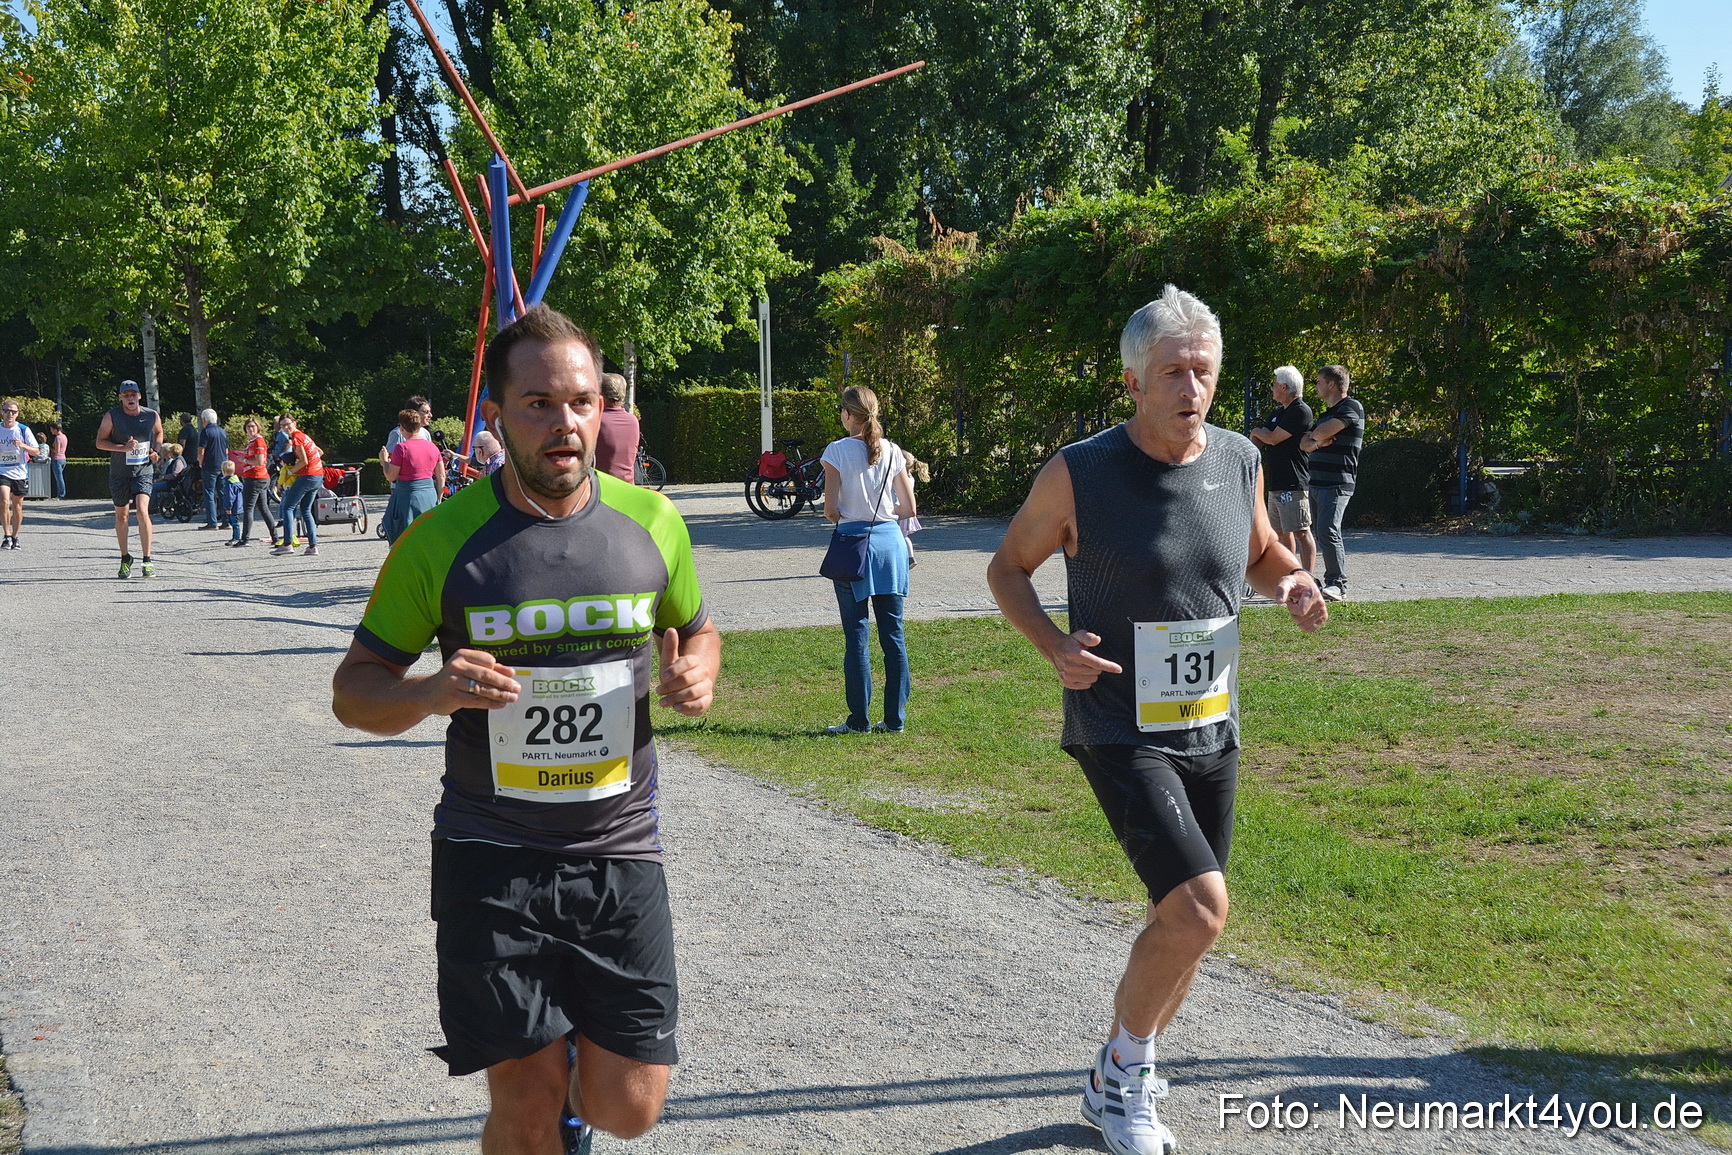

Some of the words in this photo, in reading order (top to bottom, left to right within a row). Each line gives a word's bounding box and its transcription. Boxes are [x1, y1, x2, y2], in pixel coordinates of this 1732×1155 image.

[467, 593, 656, 644] BOCK
[1170, 630, 1214, 644] BOCK
[533, 643, 551, 656] by
[556, 640, 603, 653] smart
[1164, 650, 1215, 685] 131
[532, 676, 596, 694] BOCK
[1141, 679, 1148, 687] C
[1160, 690, 1184, 698] PARTL
[1179, 702, 1204, 718] Willi
[524, 702, 604, 746] 282
[498, 735, 505, 744] A
[522, 751, 553, 760] PARTL
[554, 748, 597, 760] Neumarkt
[538, 768, 595, 787] Darius
